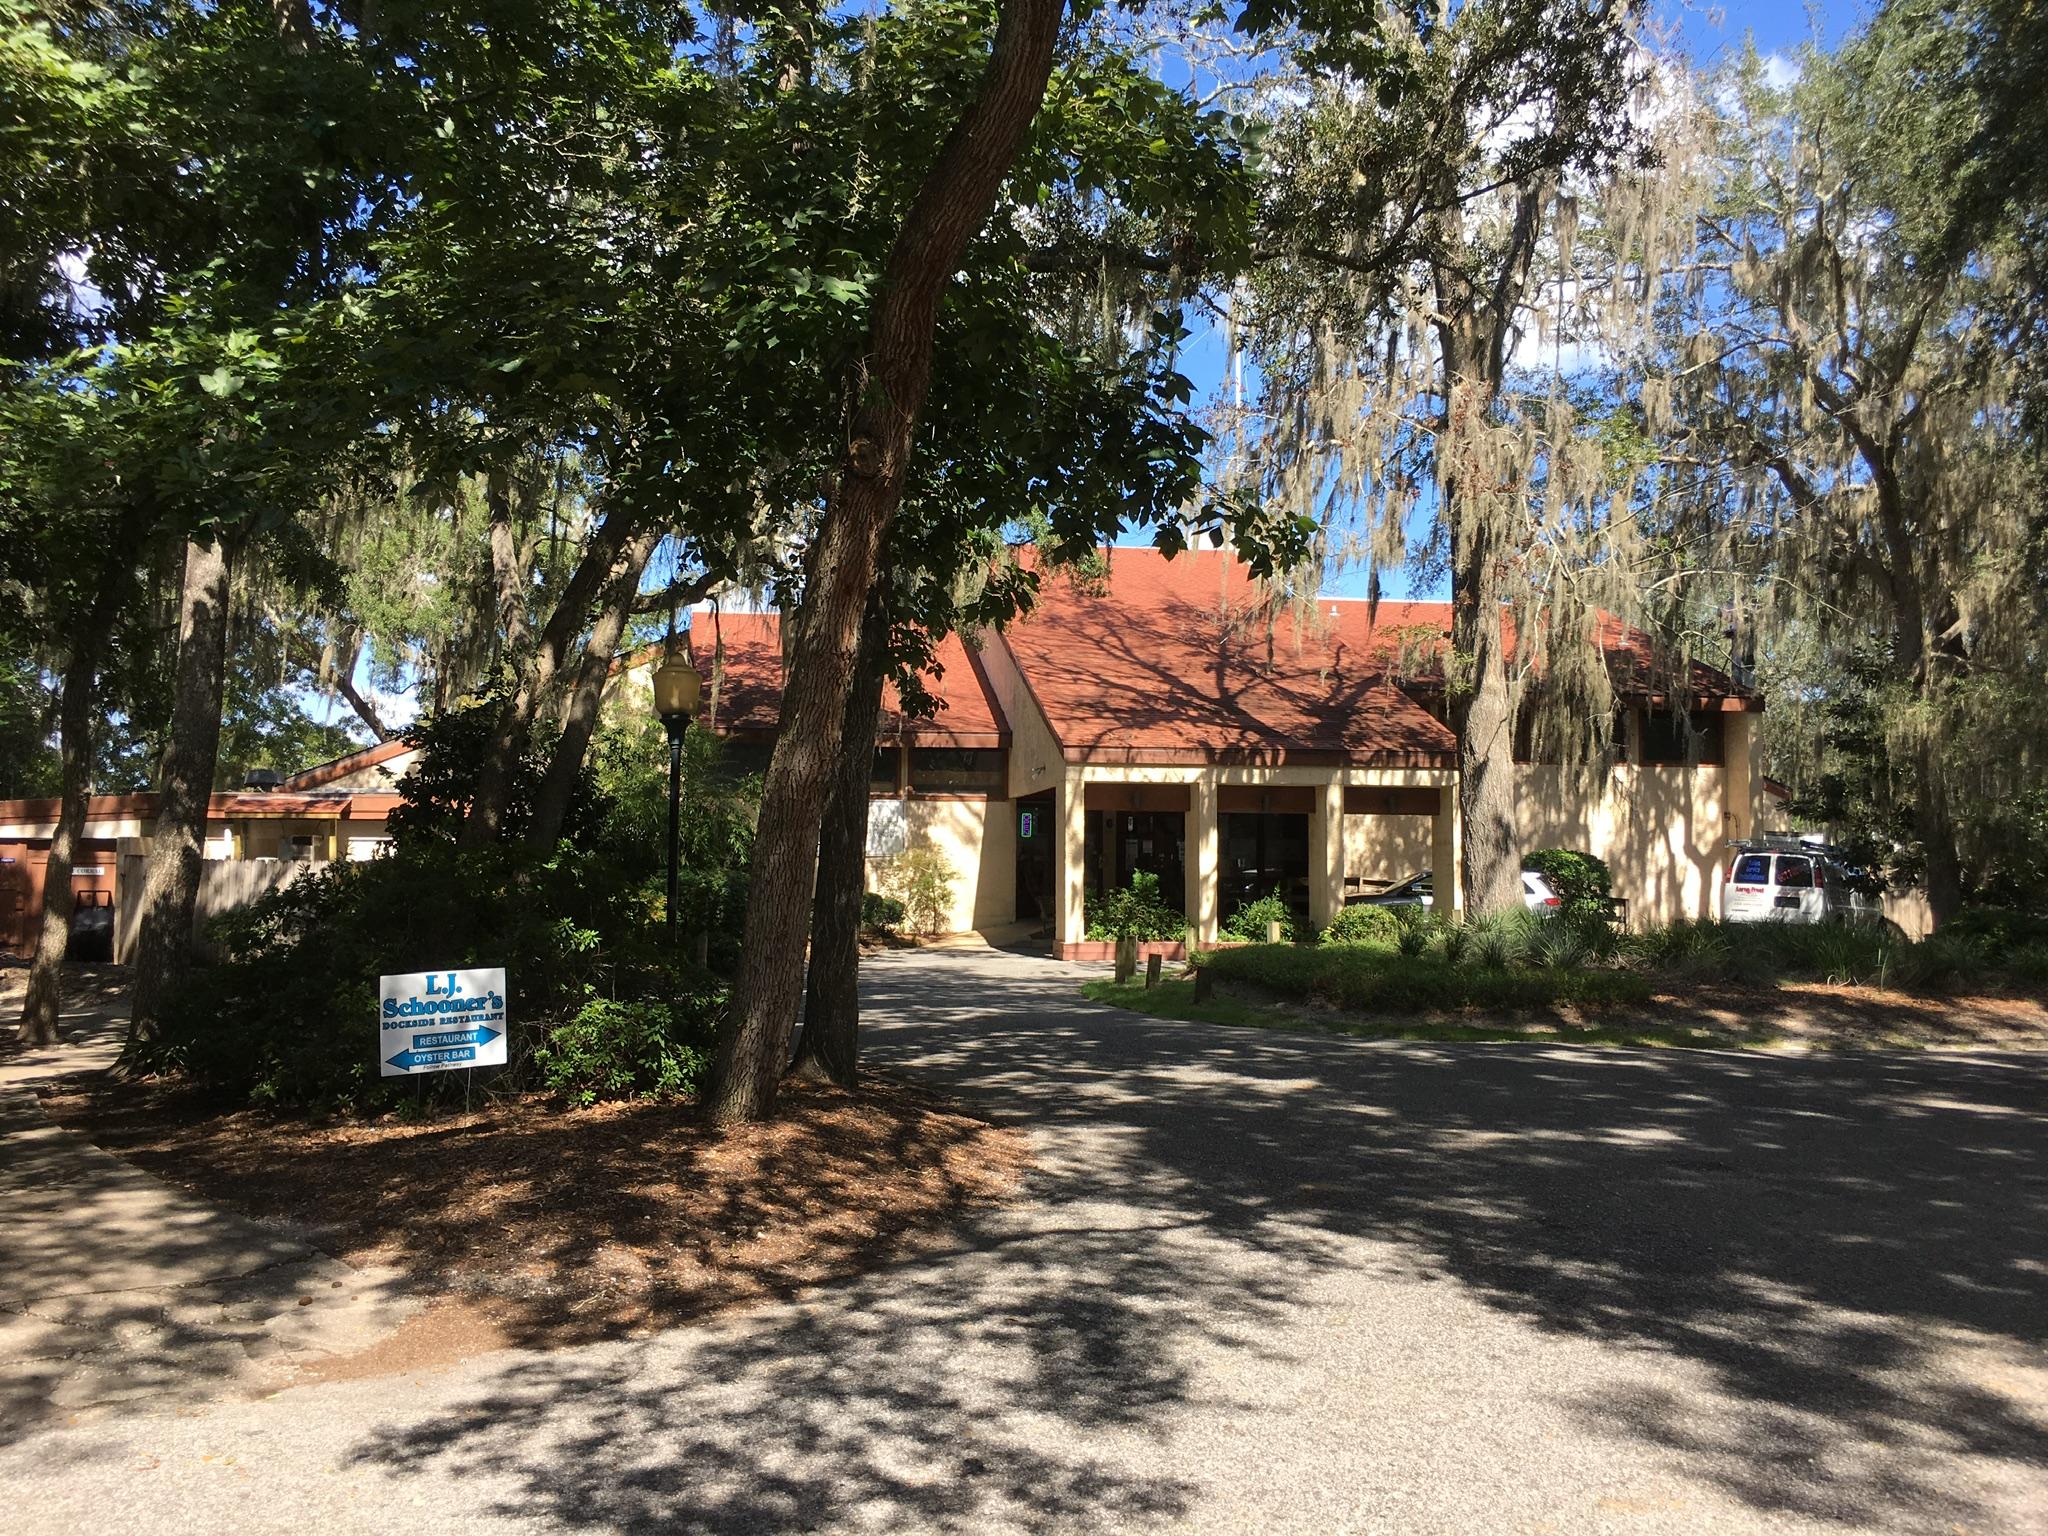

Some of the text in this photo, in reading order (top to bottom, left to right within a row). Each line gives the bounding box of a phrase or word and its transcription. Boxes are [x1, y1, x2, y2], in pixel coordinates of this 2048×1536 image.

[426, 973, 462, 999] L.J.
[383, 990, 504, 1019] Schooner's
[382, 1012, 504, 1030] DOCKSIDE RESTAURANT
[420, 1032, 478, 1046] RESTAURANT
[414, 1049, 470, 1063] OYSTER BAR
